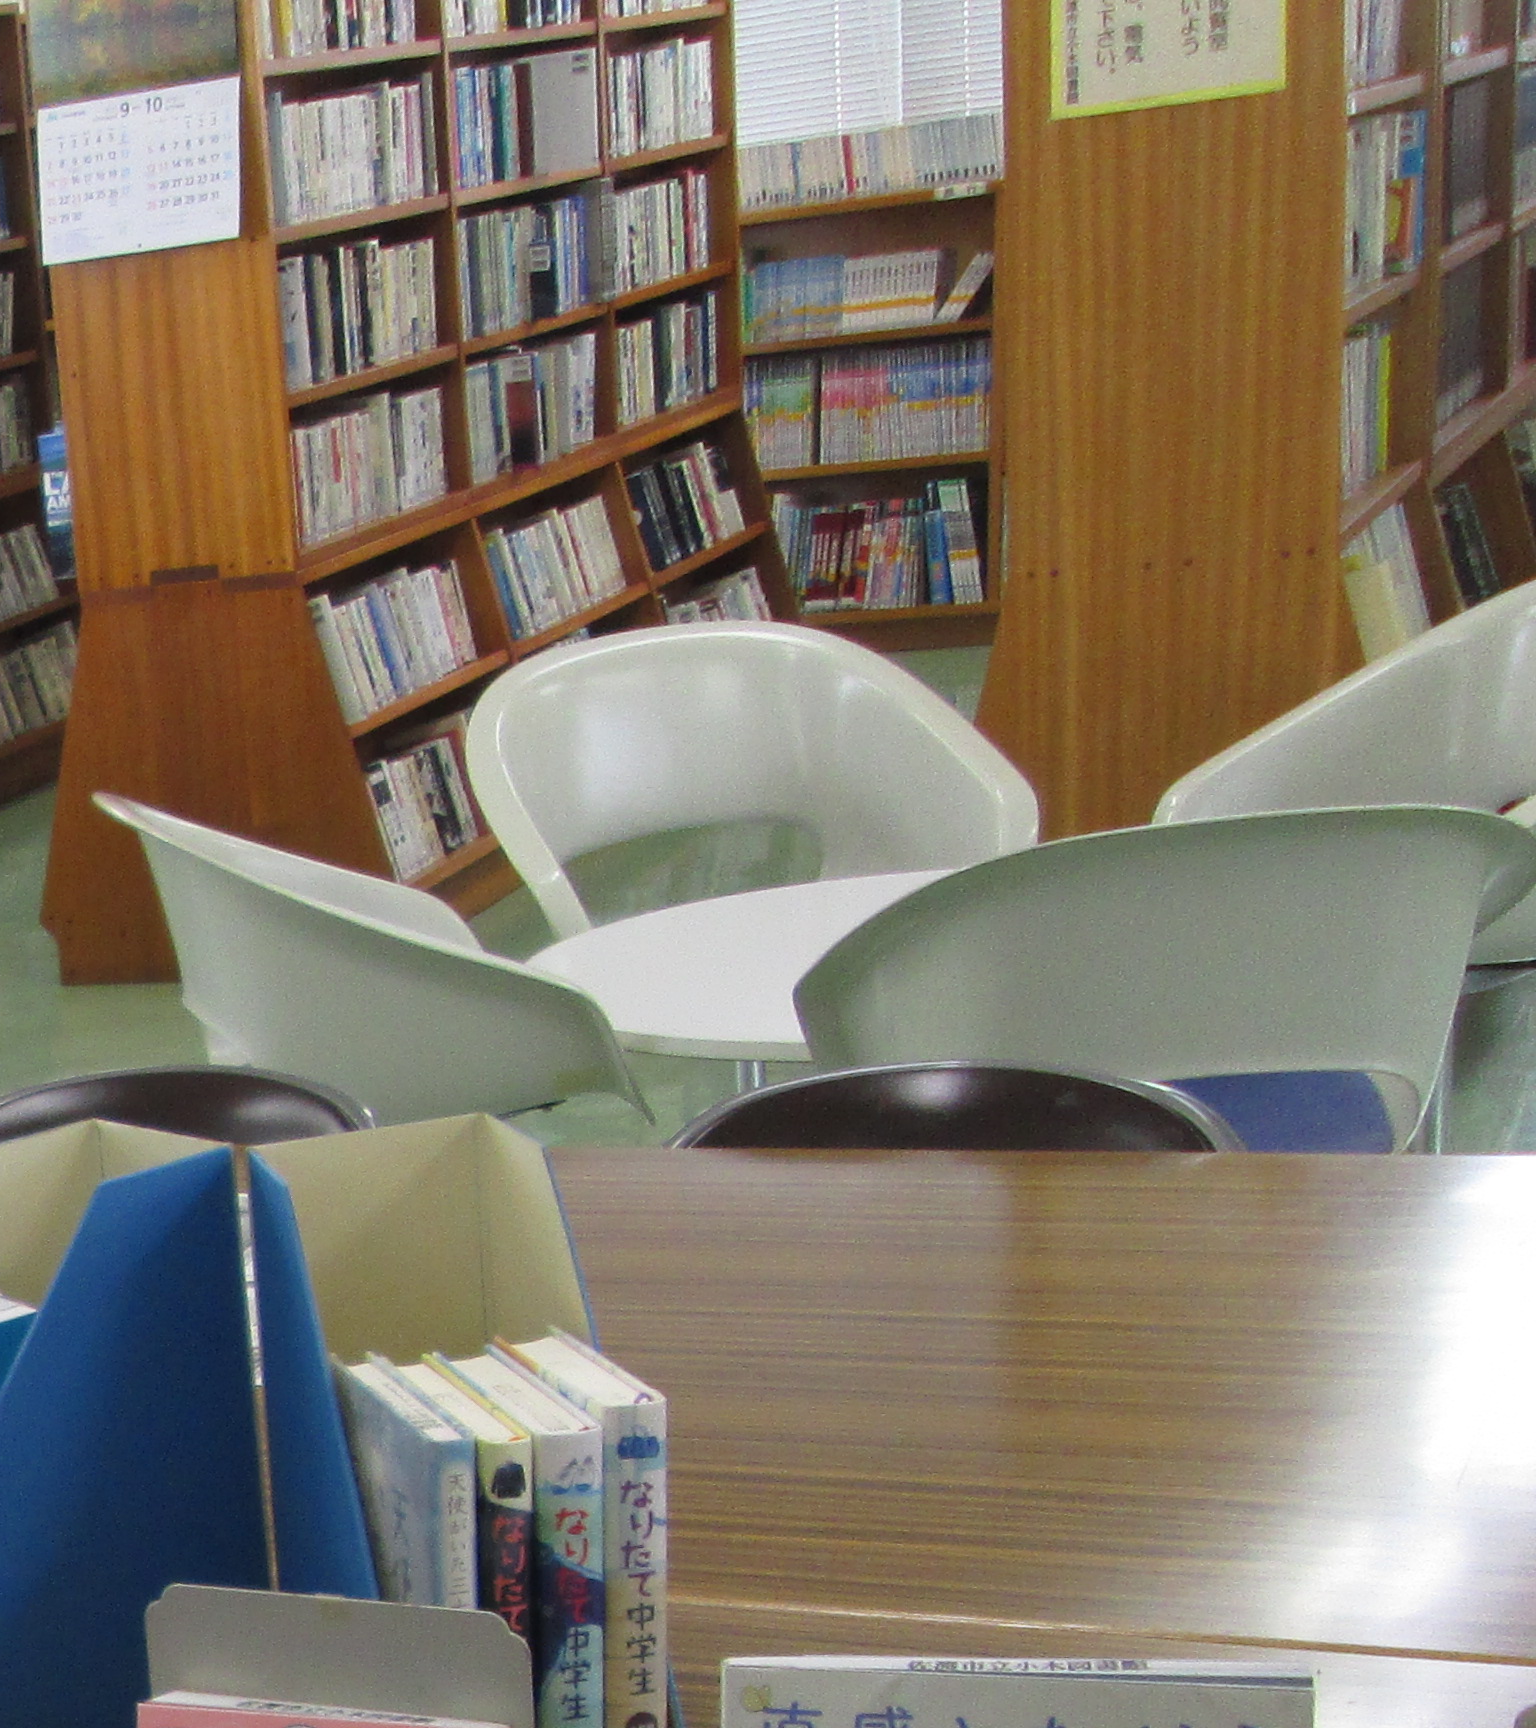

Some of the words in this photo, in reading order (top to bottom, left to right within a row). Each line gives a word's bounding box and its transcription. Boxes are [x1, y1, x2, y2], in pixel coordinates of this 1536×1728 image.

[554, 1507, 593, 1721] なりたて中学生
[619, 1480, 658, 1696] なりたて中学生
